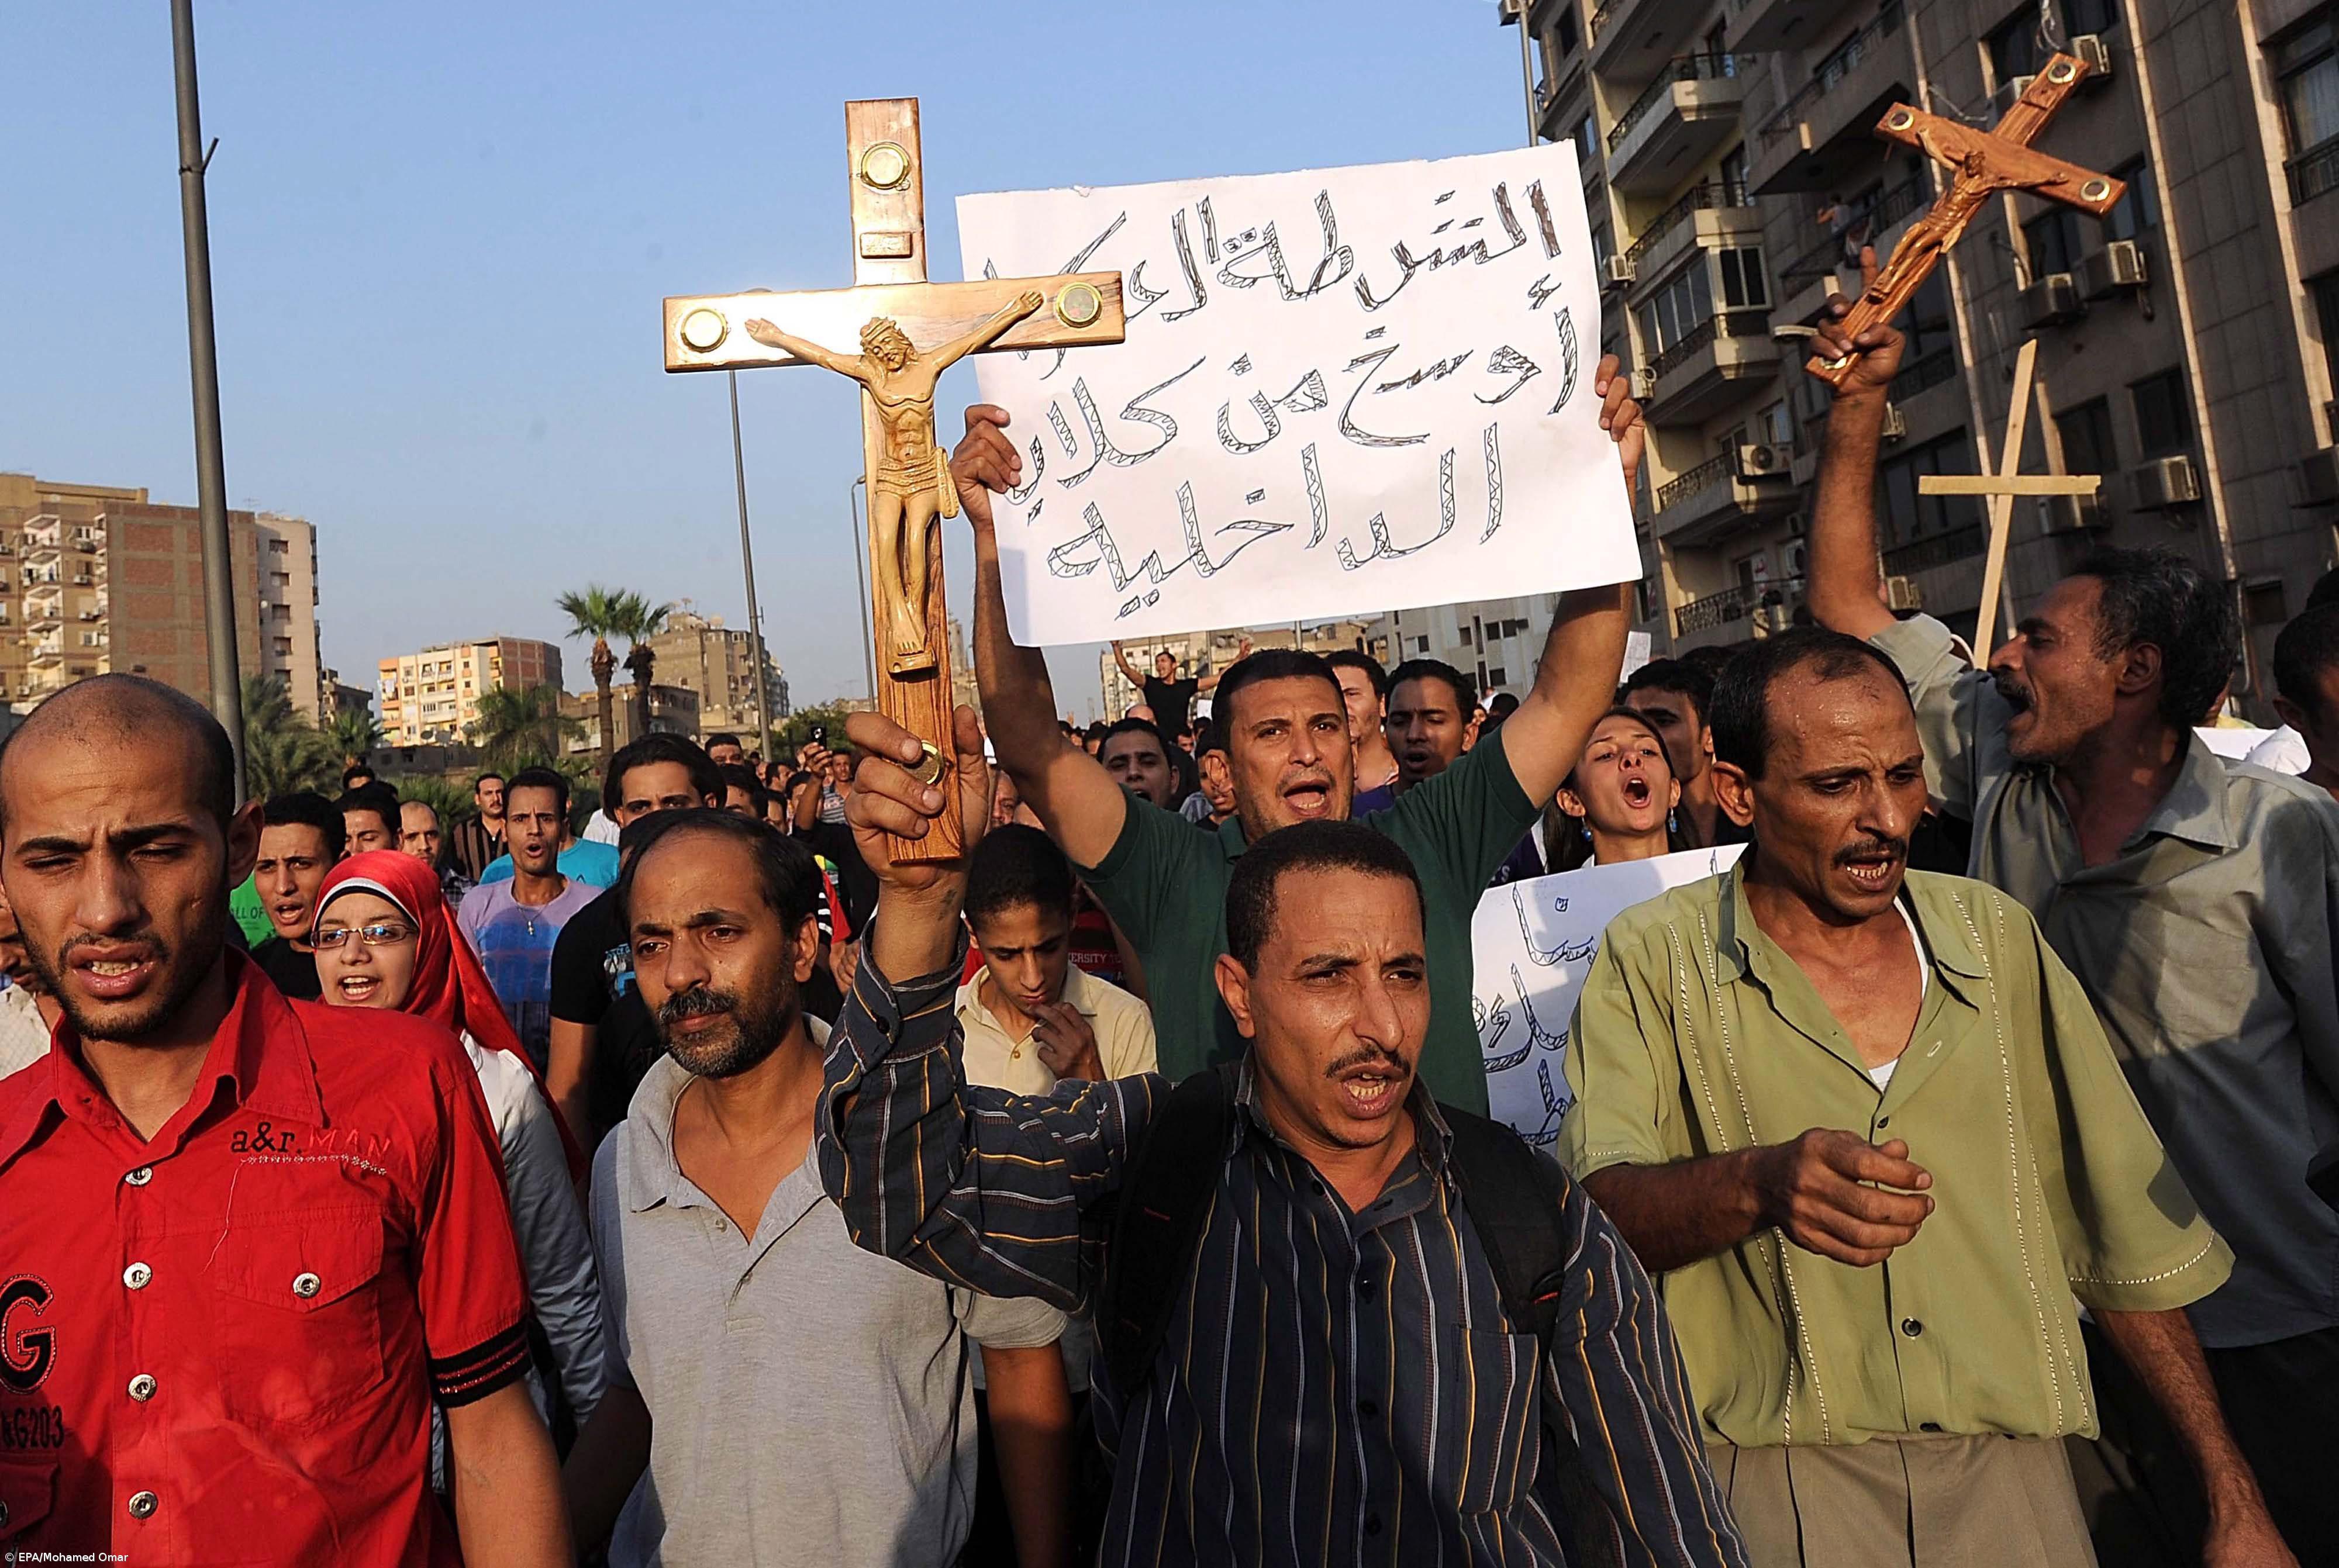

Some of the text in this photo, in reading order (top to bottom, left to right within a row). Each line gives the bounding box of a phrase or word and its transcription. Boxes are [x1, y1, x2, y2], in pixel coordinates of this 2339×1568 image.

[1217, 179, 1562, 312] الشرطة
[1217, 353, 1328, 455] من
[1047, 422, 1503, 621] الداخلية
[309, 1124, 391, 1159] MAN
